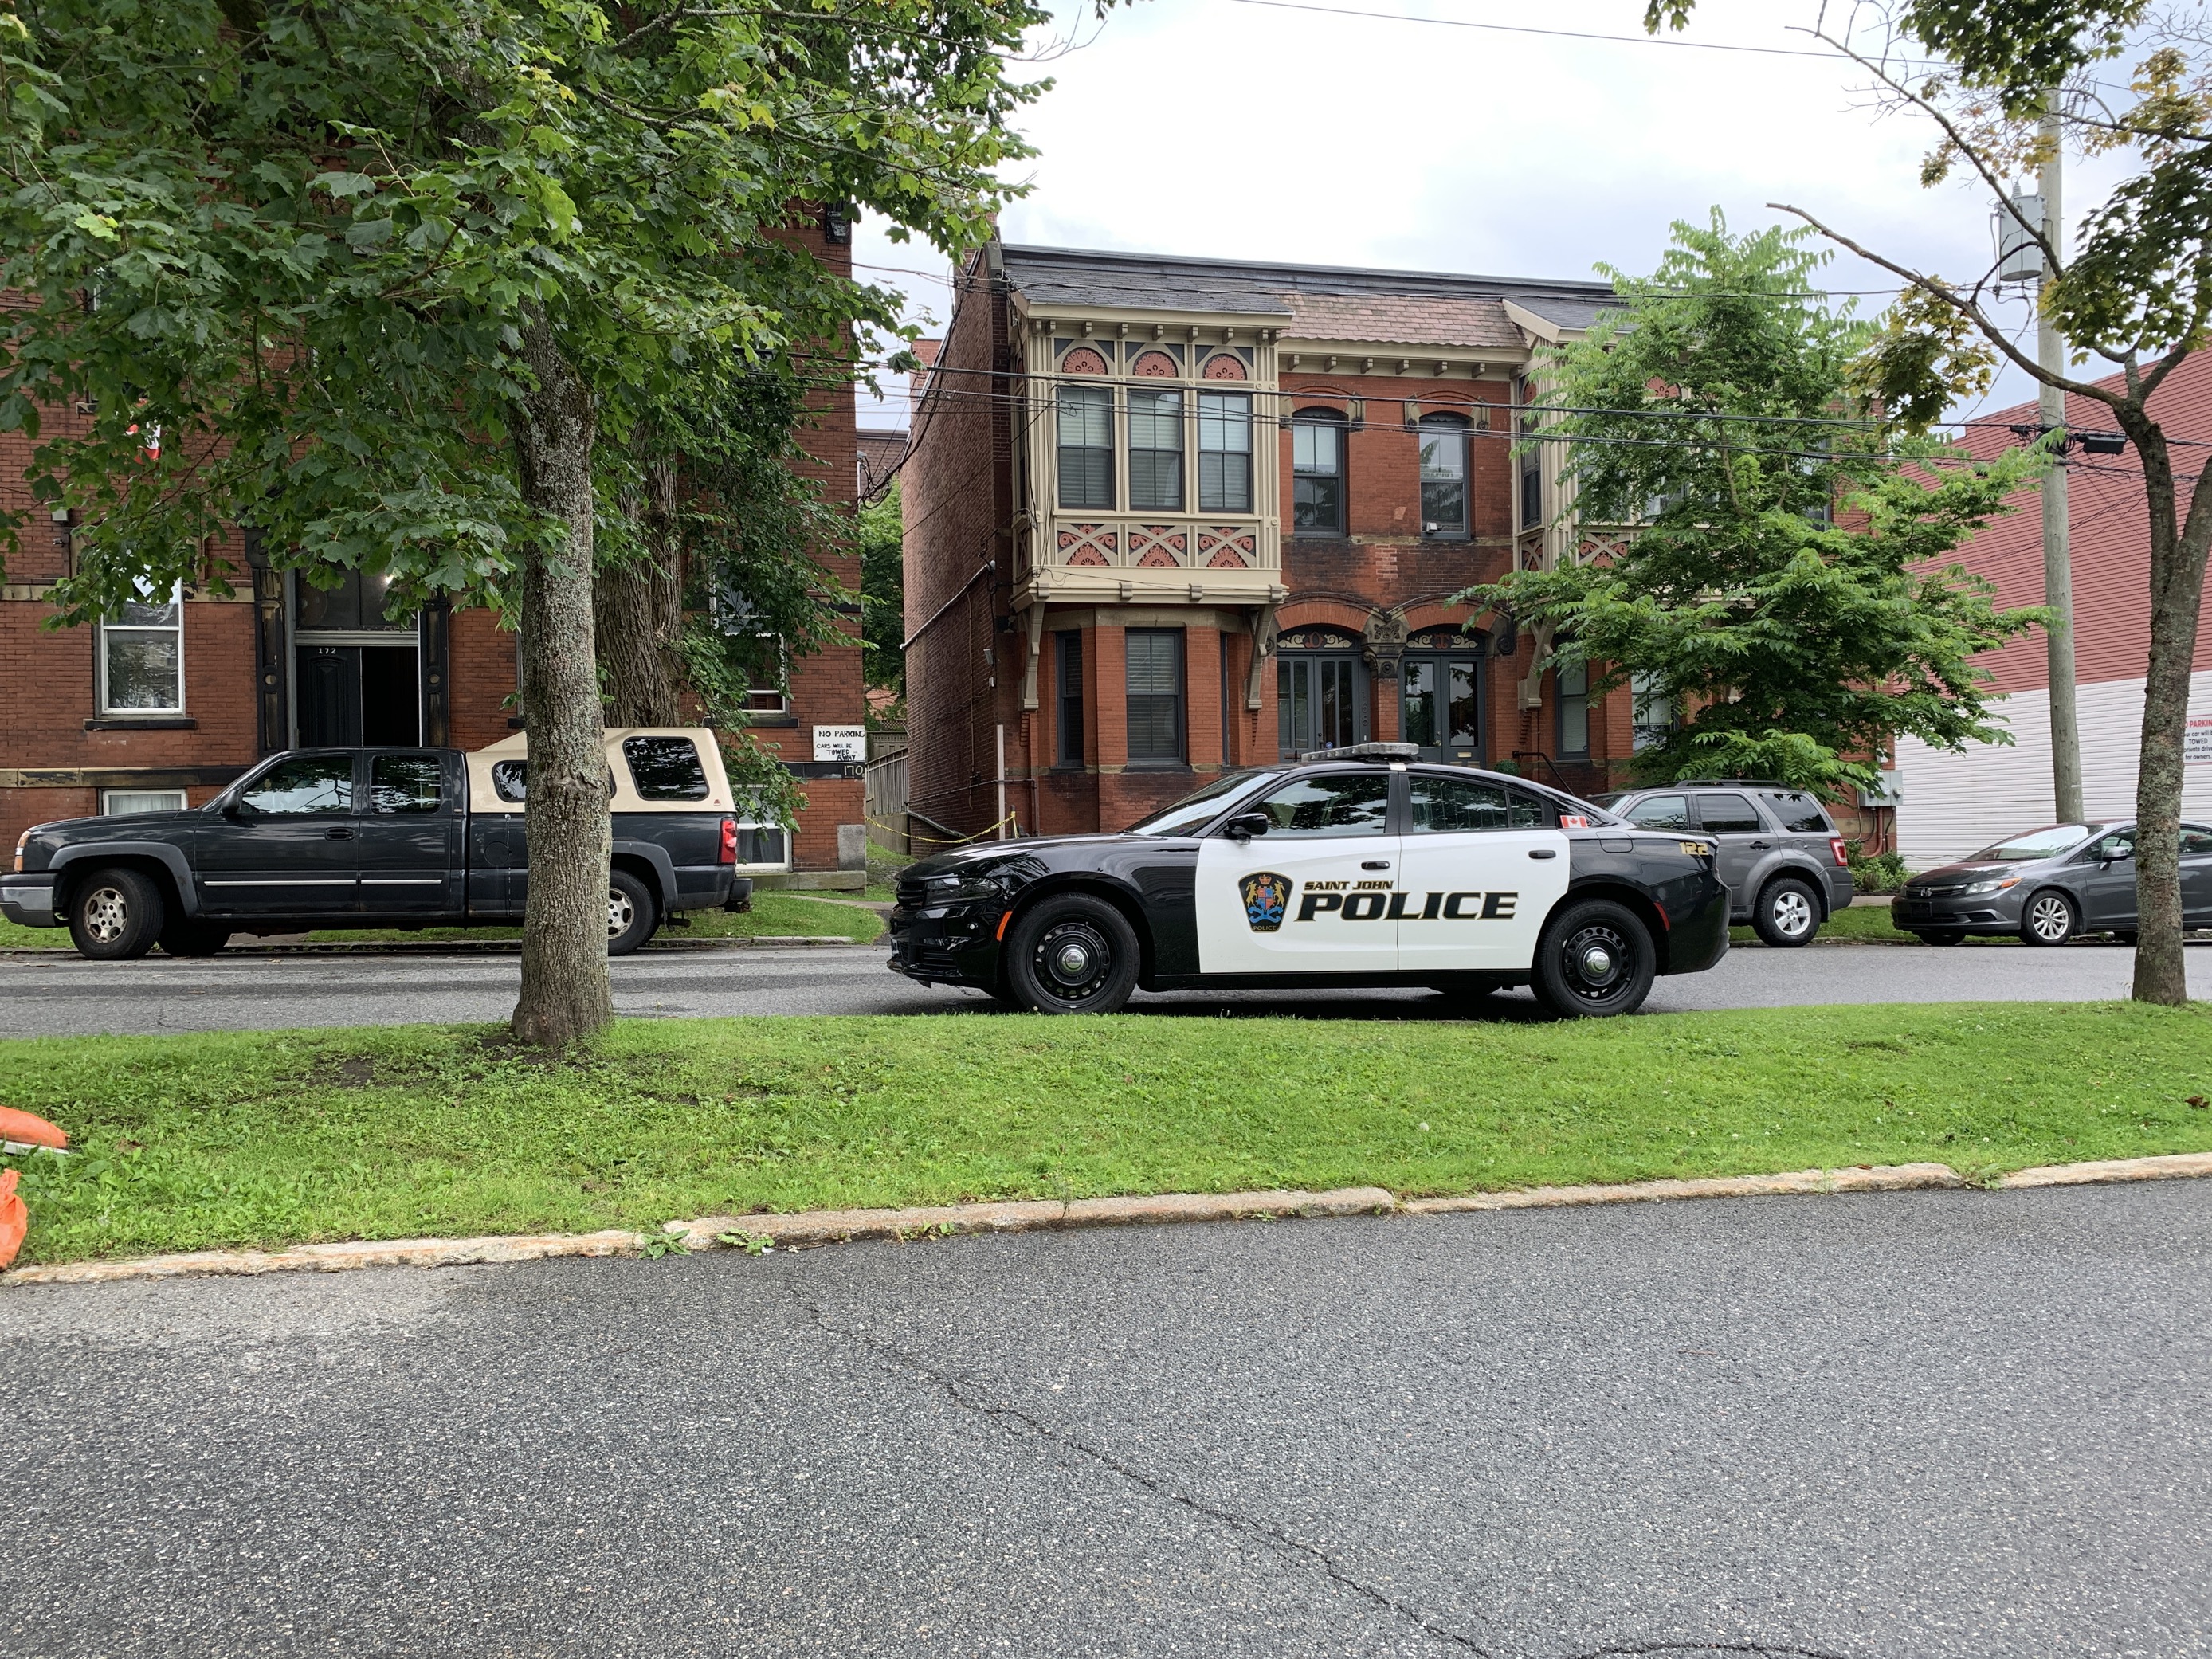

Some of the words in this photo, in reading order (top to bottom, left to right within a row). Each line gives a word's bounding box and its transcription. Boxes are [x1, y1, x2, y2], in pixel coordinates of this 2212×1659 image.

[2190, 719, 2212, 728] PARKIN
[845, 765, 863, 776] 170
[1679, 841, 1709, 856] 122
[1304, 880, 1351, 891] SAINT
[1351, 880, 1394, 891] JOHN
[1292, 891, 1520, 922] POLICE
